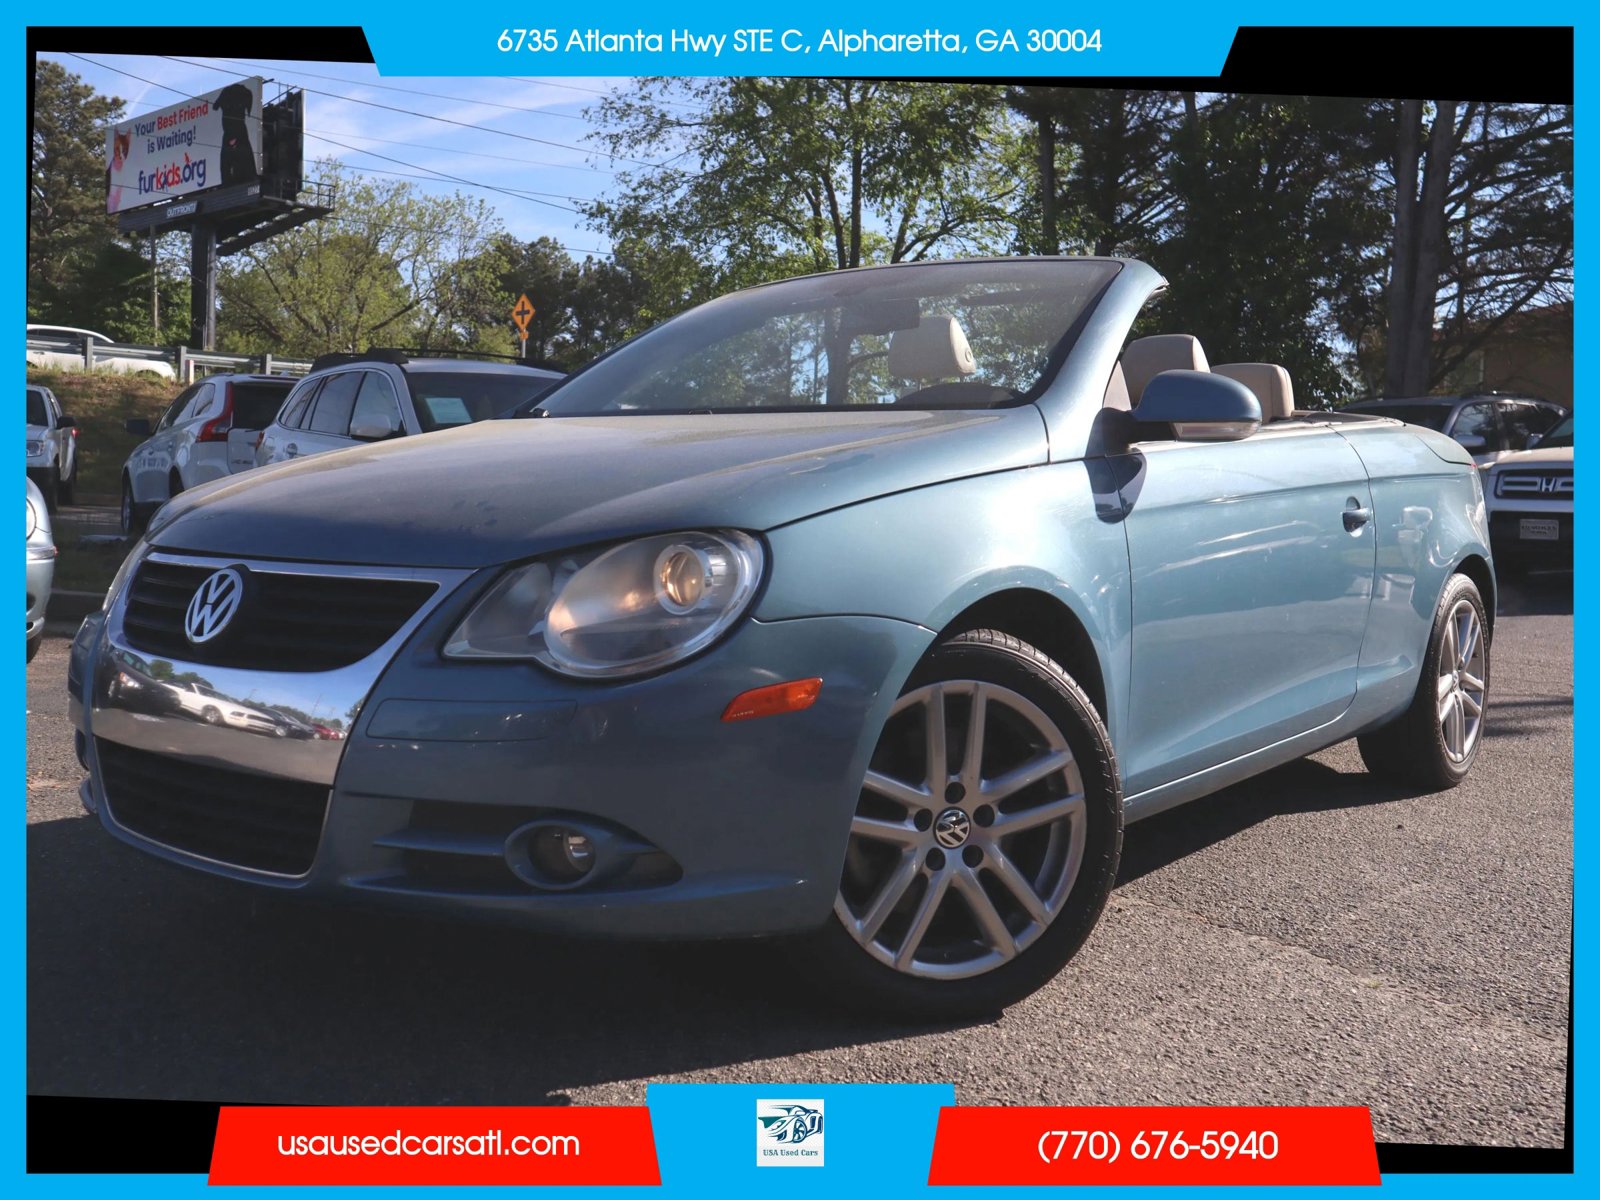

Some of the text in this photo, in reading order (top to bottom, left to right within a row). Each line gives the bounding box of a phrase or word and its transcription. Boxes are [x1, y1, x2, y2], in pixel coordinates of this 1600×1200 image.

[135, 100, 209, 137] Your Best Friend
[147, 125, 196, 154] is Waiting!
[138, 157, 207, 195] furkids.org
